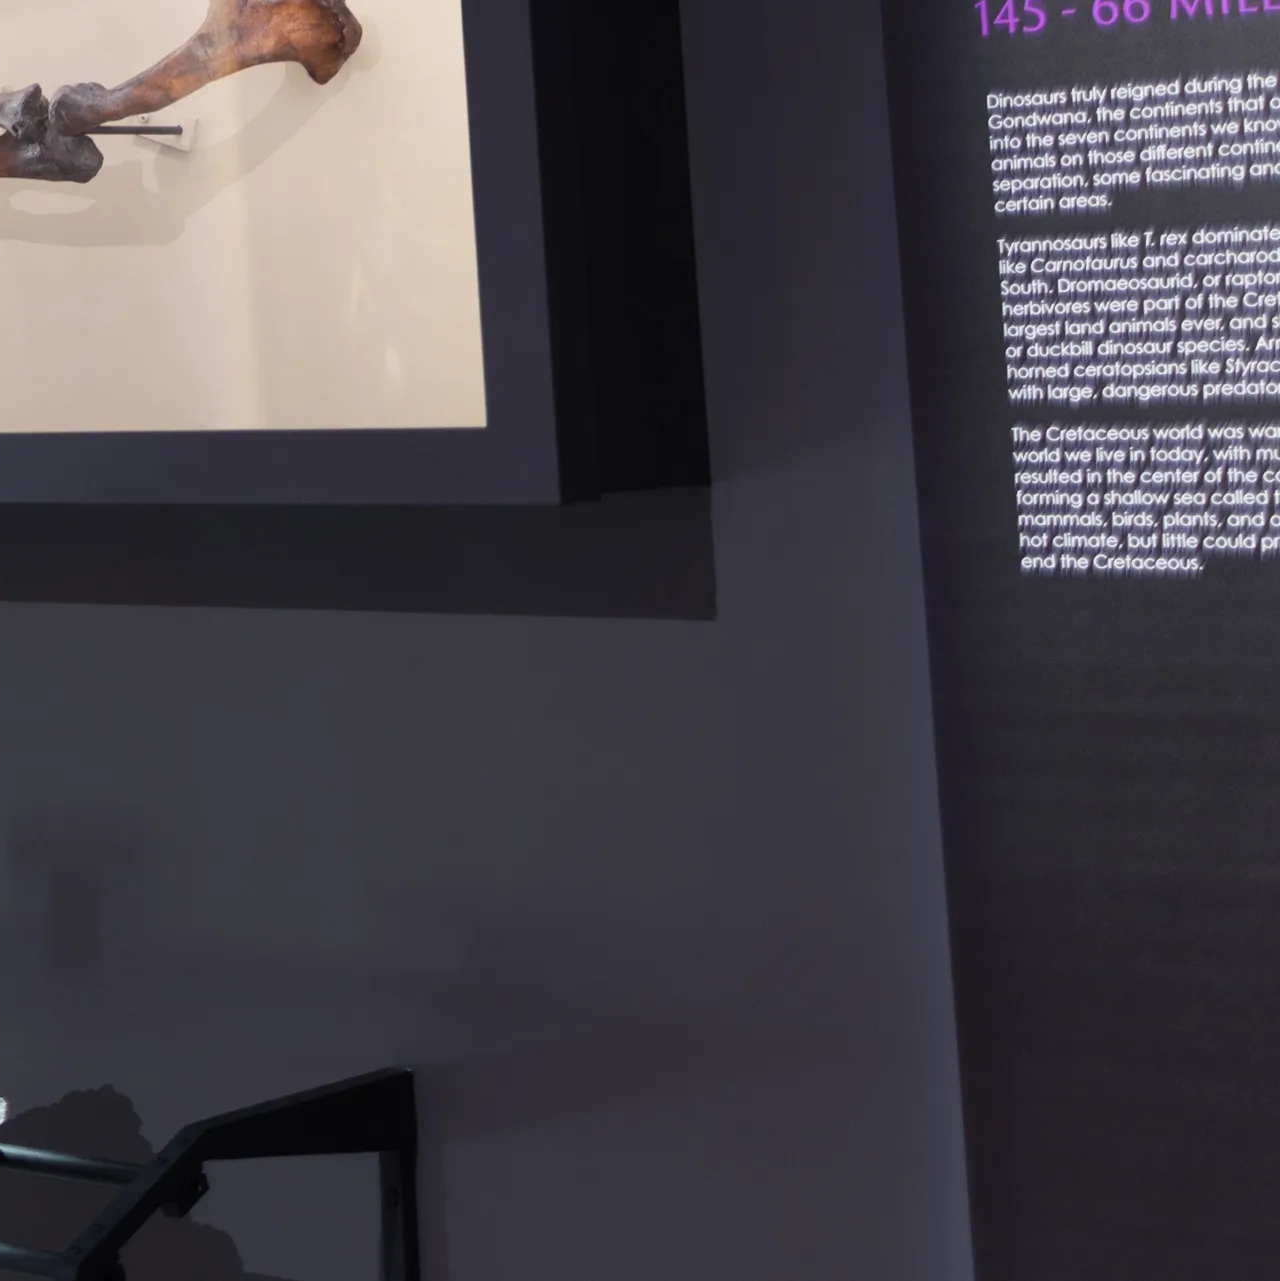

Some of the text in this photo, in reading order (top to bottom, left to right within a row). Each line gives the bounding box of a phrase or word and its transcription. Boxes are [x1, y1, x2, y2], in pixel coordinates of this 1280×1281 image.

[987, 73, 1277, 109] Dinosaurs truly reigned during the
[1096, 105, 1125, 122] the
[1130, 99, 1223, 119] continents
[1228, 95, 1264, 112] that
[990, 134, 1021, 150] into
[1026, 131, 1054, 147] the
[1058, 131, 1109, 145] seven
[1114, 122, 1207, 142] continents
[1211, 122, 1239, 135] we
[992, 152, 1056, 171] animals
[1061, 154, 1083, 166] on
[1088, 148, 1135, 165] those
[1140, 142, 1213, 161] different
[1093, 171, 1141, 185] some
[1146, 163, 1245, 182] fascinating
[995, 195, 1054, 213] certain
[997, 237, 1107, 257] Tyrannosaurs
[1111, 231, 1140, 248] like
[1160, 233, 1187, 246] rex
[999, 257, 1026, 274] like
[1031, 256, 1138, 273] Carnotaurus
[1143, 251, 1179, 268] and
[1203, 274, 1221, 286] or
[1003, 299, 1090, 316] herbivores
[1094, 299, 1138, 312] were
[1144, 294, 1180, 314] part
[1185, 292, 1203, 309] of
[1209, 291, 1238, 308] the
[1004, 320, 1060, 340] largest
[1065, 318, 1104, 335] land
[1109, 316, 1176, 333] animals
[1230, 313, 1267, 329] and
[1006, 345, 1022, 357] or
[1027, 339, 1093, 356] duckbill
[1098, 339, 1172, 355] dinosaur
[1007, 362, 1069, 379] horned
[1074, 361, 1187, 380] ceratopsians
[1191, 359, 1220, 375] like
[1009, 382, 1043, 399] with
[1102, 381, 1198, 401] dangerous
[1011, 426, 1041, 442] The
[1046, 425, 1149, 441] Cretaceous
[1153, 423, 1203, 440] world
[1208, 427, 1244, 439] was
[1013, 447, 1060, 463] world
[1065, 450, 1092, 462] we
[1096, 446, 1125, 462] live
[1130, 447, 1145, 462] in
[1213, 444, 1251, 461] with
[1015, 468, 1082, 484] resulted
[1087, 469, 1102, 484] in
[1107, 468, 1136, 484] the
[1140, 468, 1199, 484] center
[1204, 467, 1222, 483] of
[1228, 467, 1258, 483] the
[1017, 489, 1083, 509] forming
[1087, 493, 1099, 505] a
[1104, 489, 1169, 505] shallow
[1174, 492, 1206, 504] sea
[1211, 488, 1269, 504] called
[1227, 510, 1265, 526] and
[1020, 531, 1048, 547] hot
[1128, 532, 1157, 548] but
[1162, 532, 1198, 548] little
[1203, 533, 1256, 549] could
[1021, 552, 1056, 568] end
[1061, 553, 1089, 569] the
